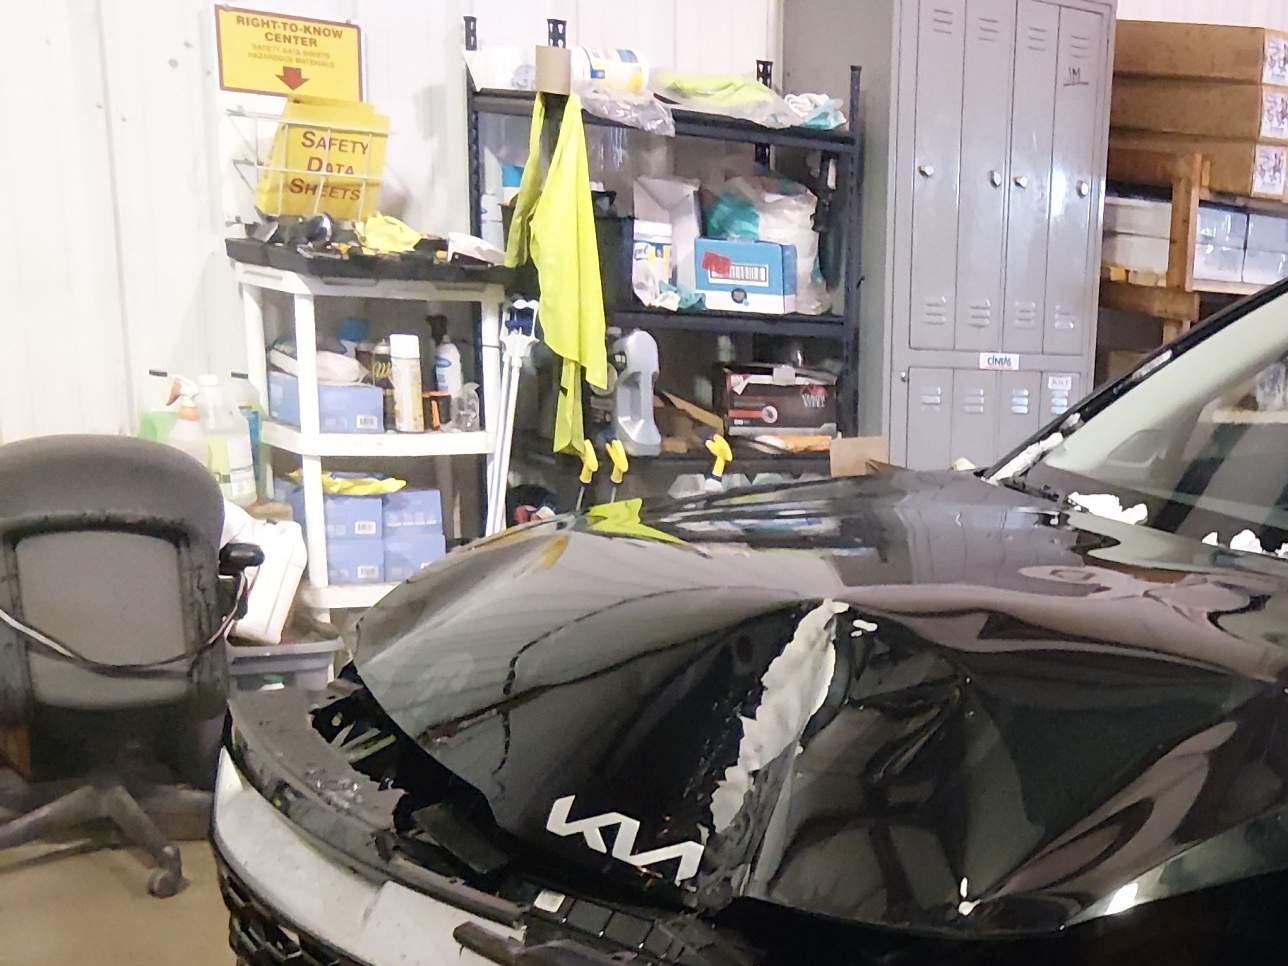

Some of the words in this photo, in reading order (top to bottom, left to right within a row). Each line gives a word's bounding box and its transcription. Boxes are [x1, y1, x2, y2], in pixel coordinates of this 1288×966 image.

[235, 15, 343, 39] RIGHT-TO-KNOW
[264, 32, 318, 47] CENTER
[301, 130, 369, 155] SAFETY
[307, 155, 354, 174] DATA
[289, 178, 361, 201] SHEETS
[546, 795, 704, 886] KIA
